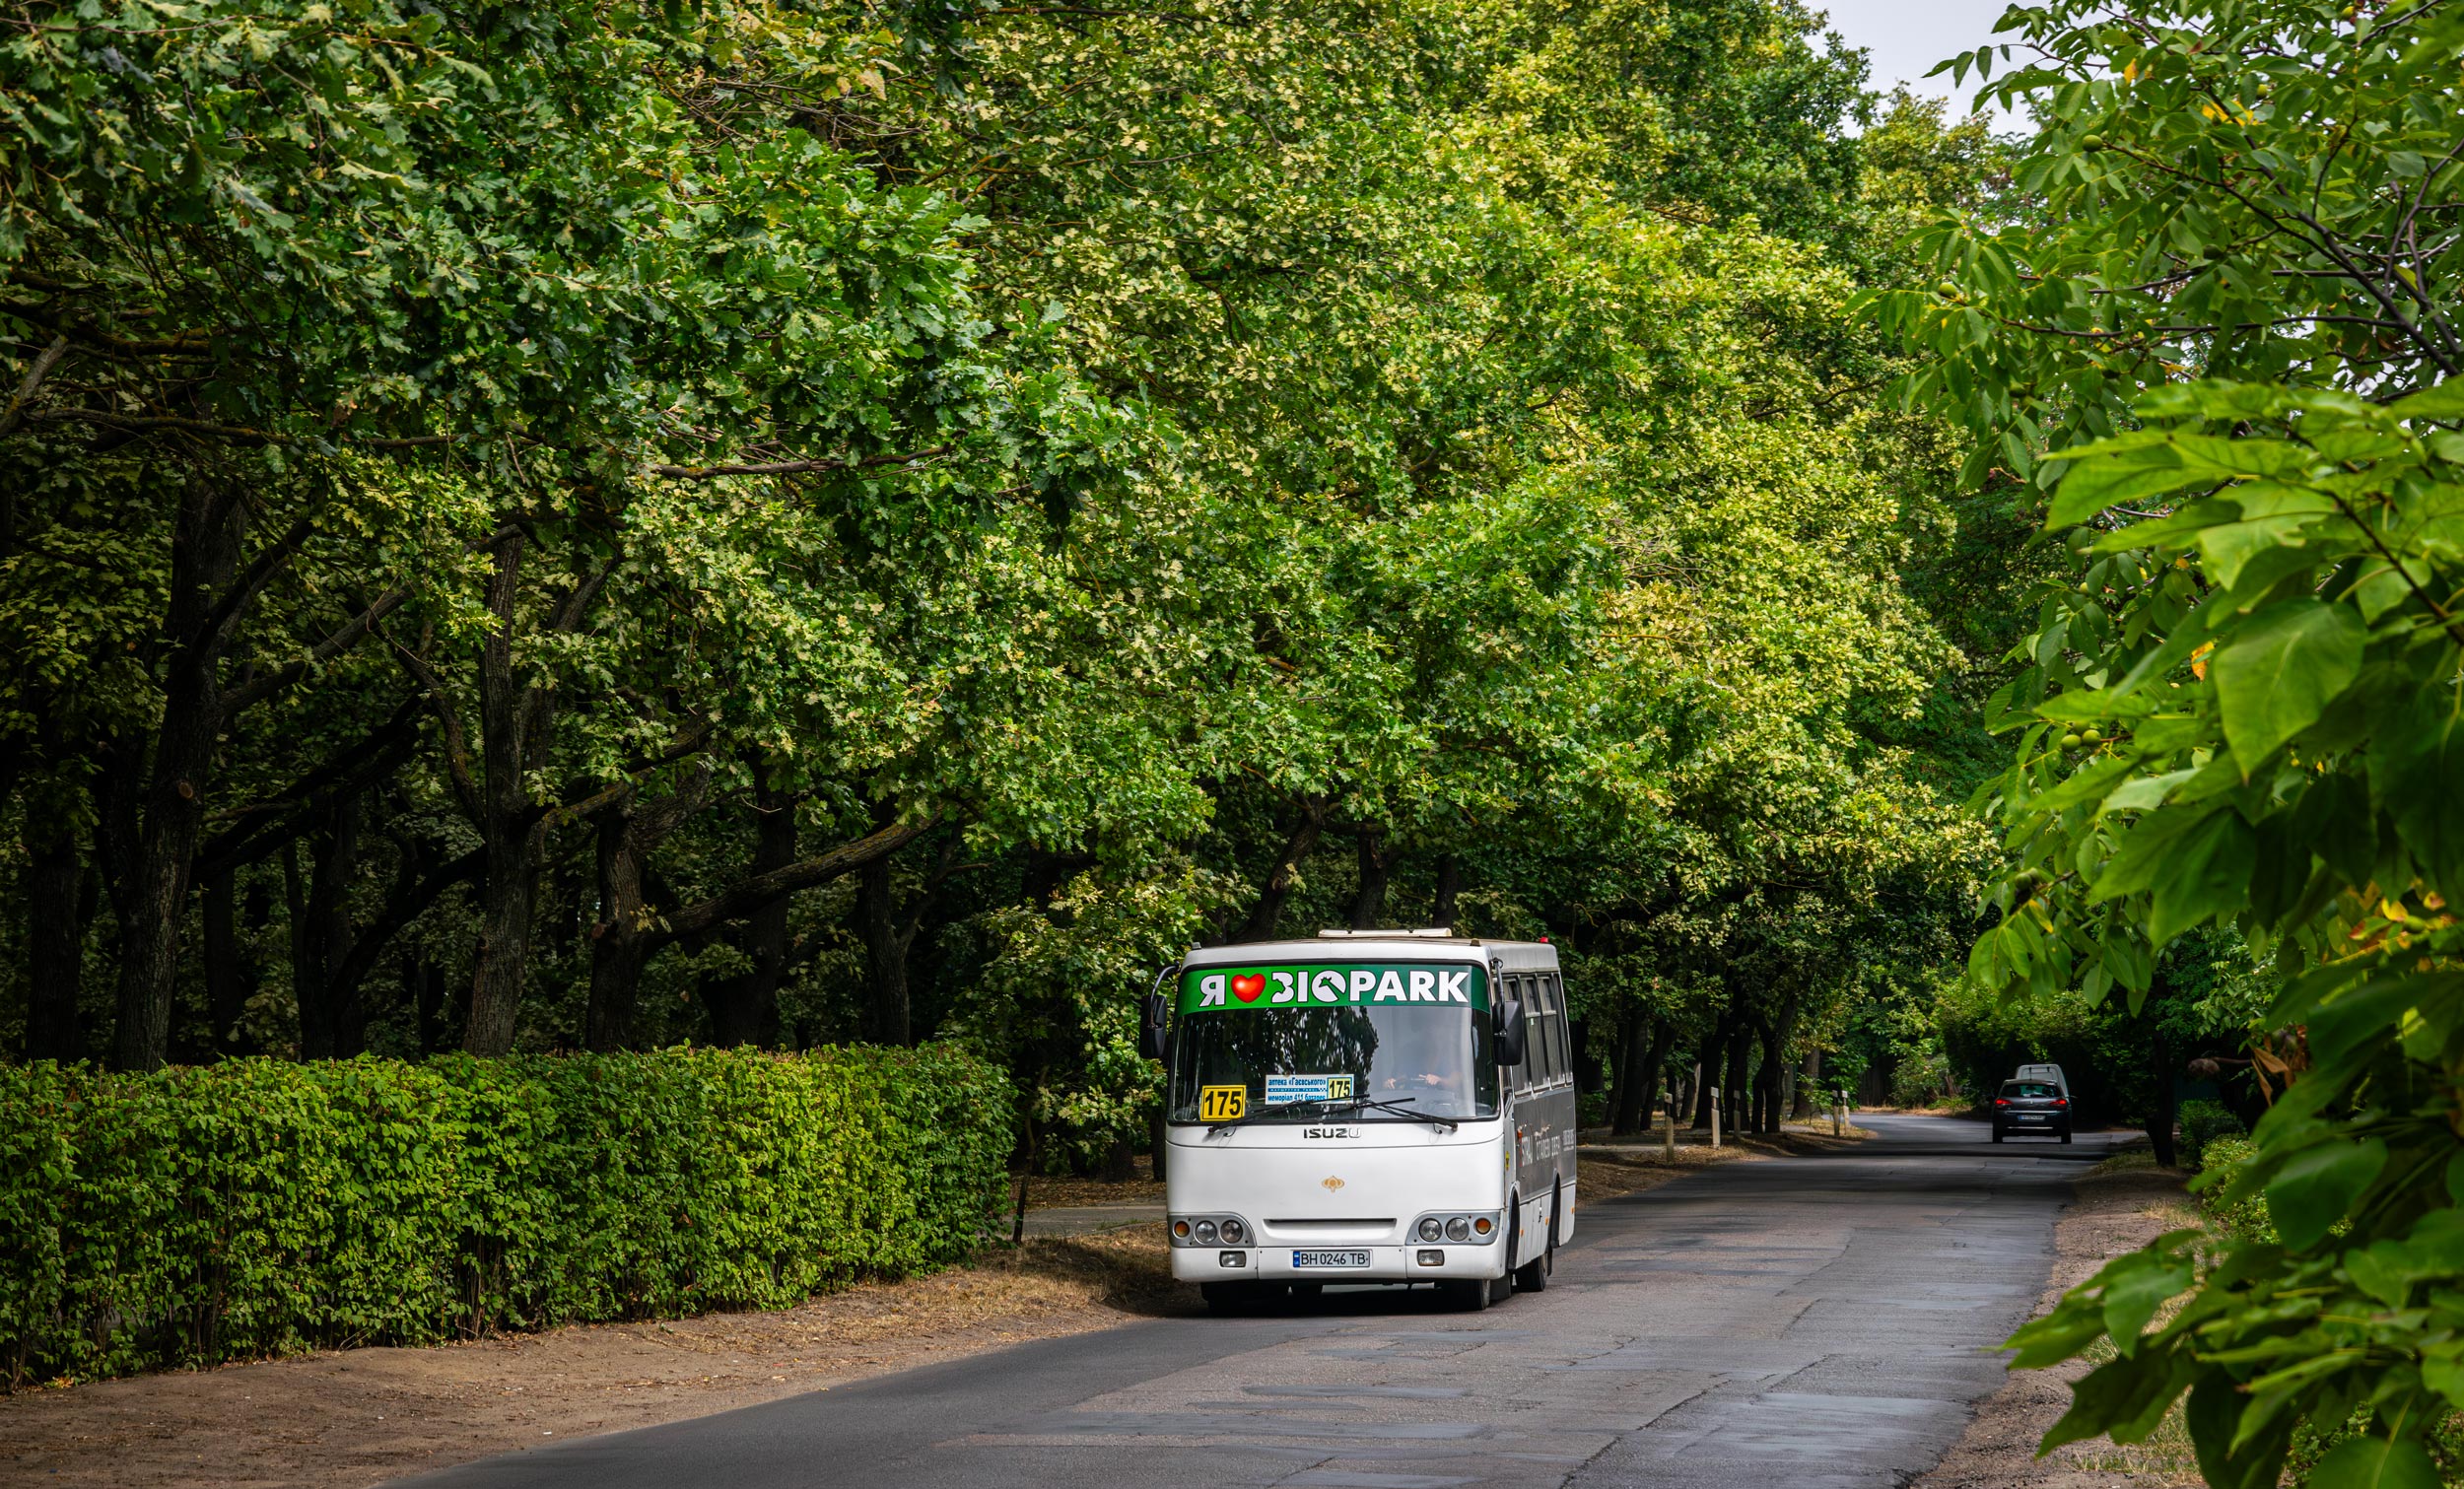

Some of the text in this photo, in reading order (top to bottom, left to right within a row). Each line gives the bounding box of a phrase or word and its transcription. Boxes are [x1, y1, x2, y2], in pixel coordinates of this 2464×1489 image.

[1198, 974, 1226, 1007] Я
[1329, 1080, 1351, 1099] 175
[1204, 1090, 1242, 1117] 175
[1304, 1128, 1362, 1139] ISUZU
[1301, 1252, 1318, 1264] BH
[1320, 1252, 1346, 1264] 0246
[1349, 1252, 1366, 1264] TB
